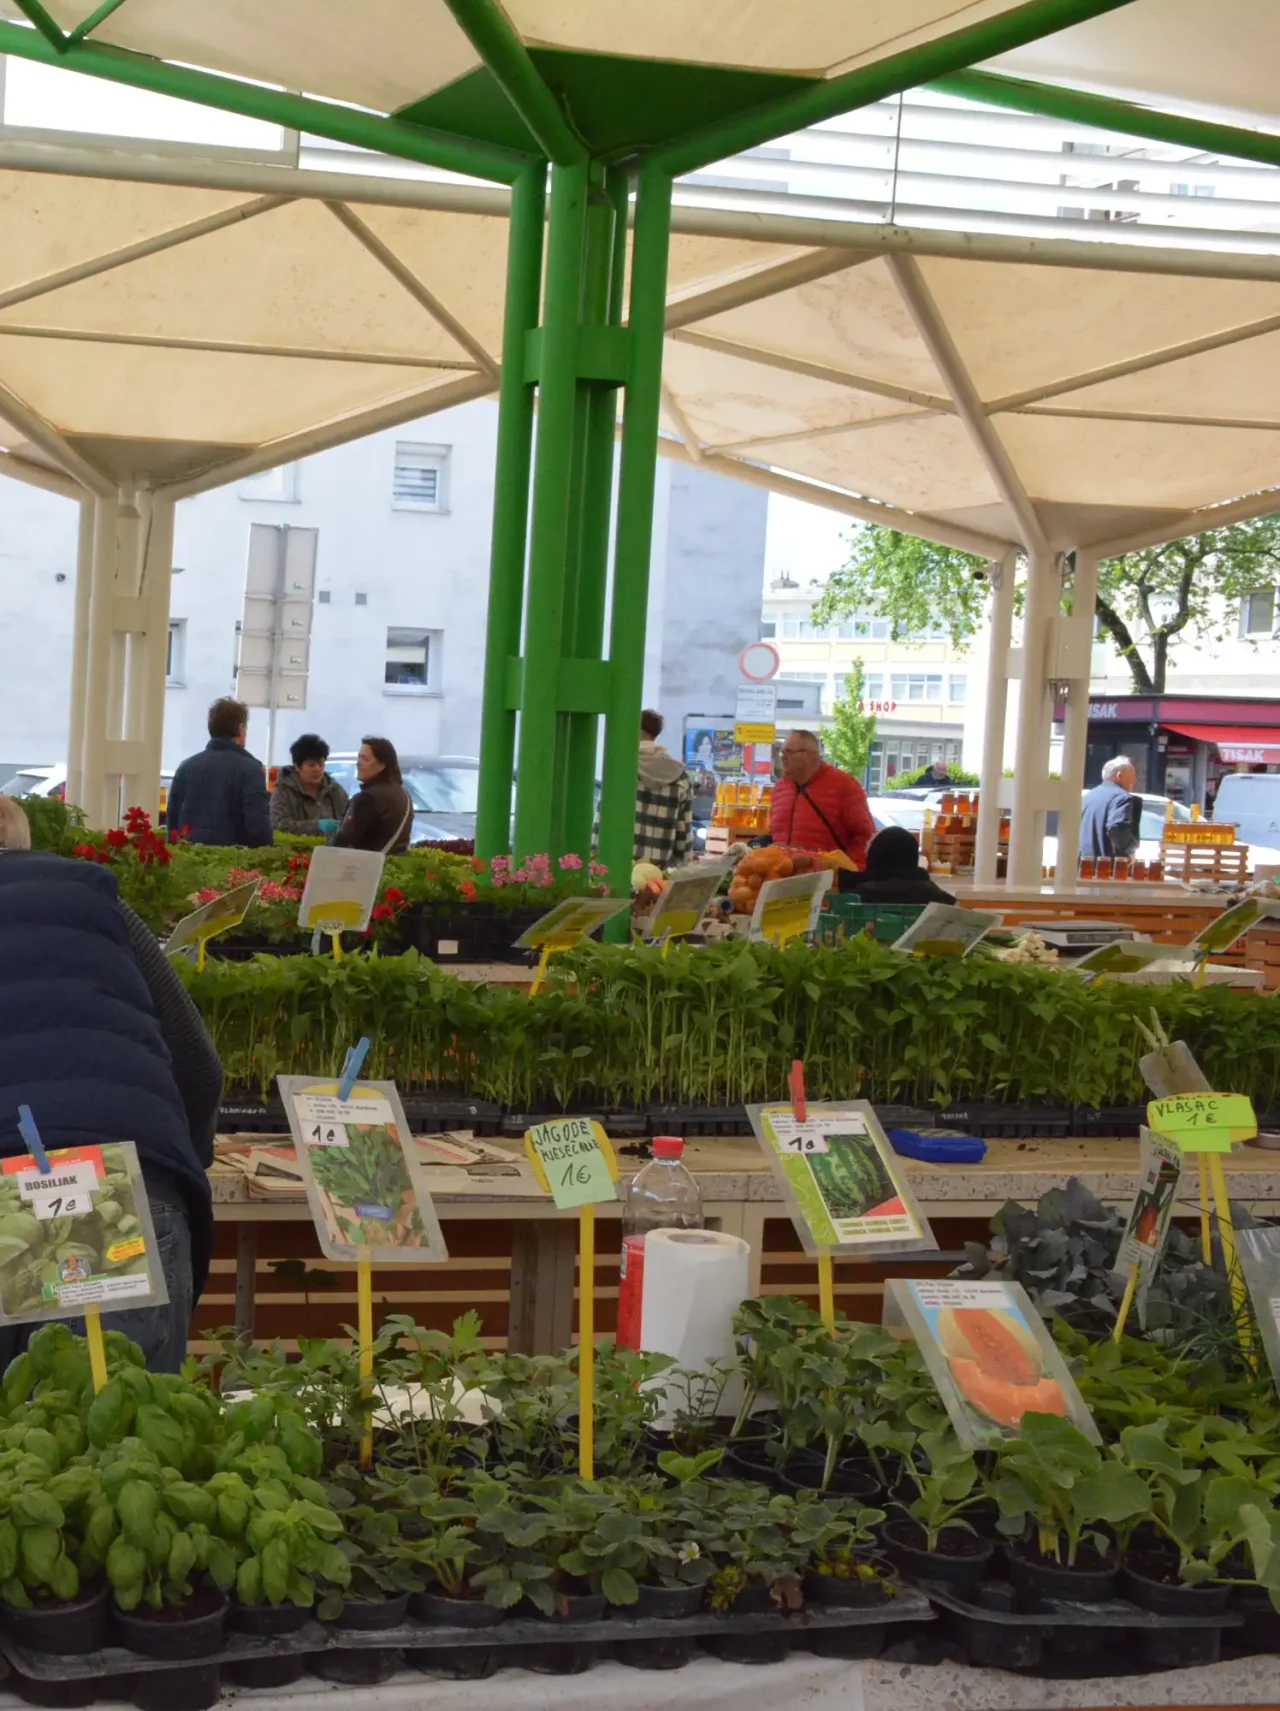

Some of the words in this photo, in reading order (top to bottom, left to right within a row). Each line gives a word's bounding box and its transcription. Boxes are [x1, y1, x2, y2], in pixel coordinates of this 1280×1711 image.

[1088, 703, 1117, 718] ISAK
[1223, 748, 1264, 761] TISAK
[1155, 1100, 1219, 1118] VLASAC
[535, 1121, 591, 1146] JAGODE
[24, 1175, 78, 1191] BOSILJAK
